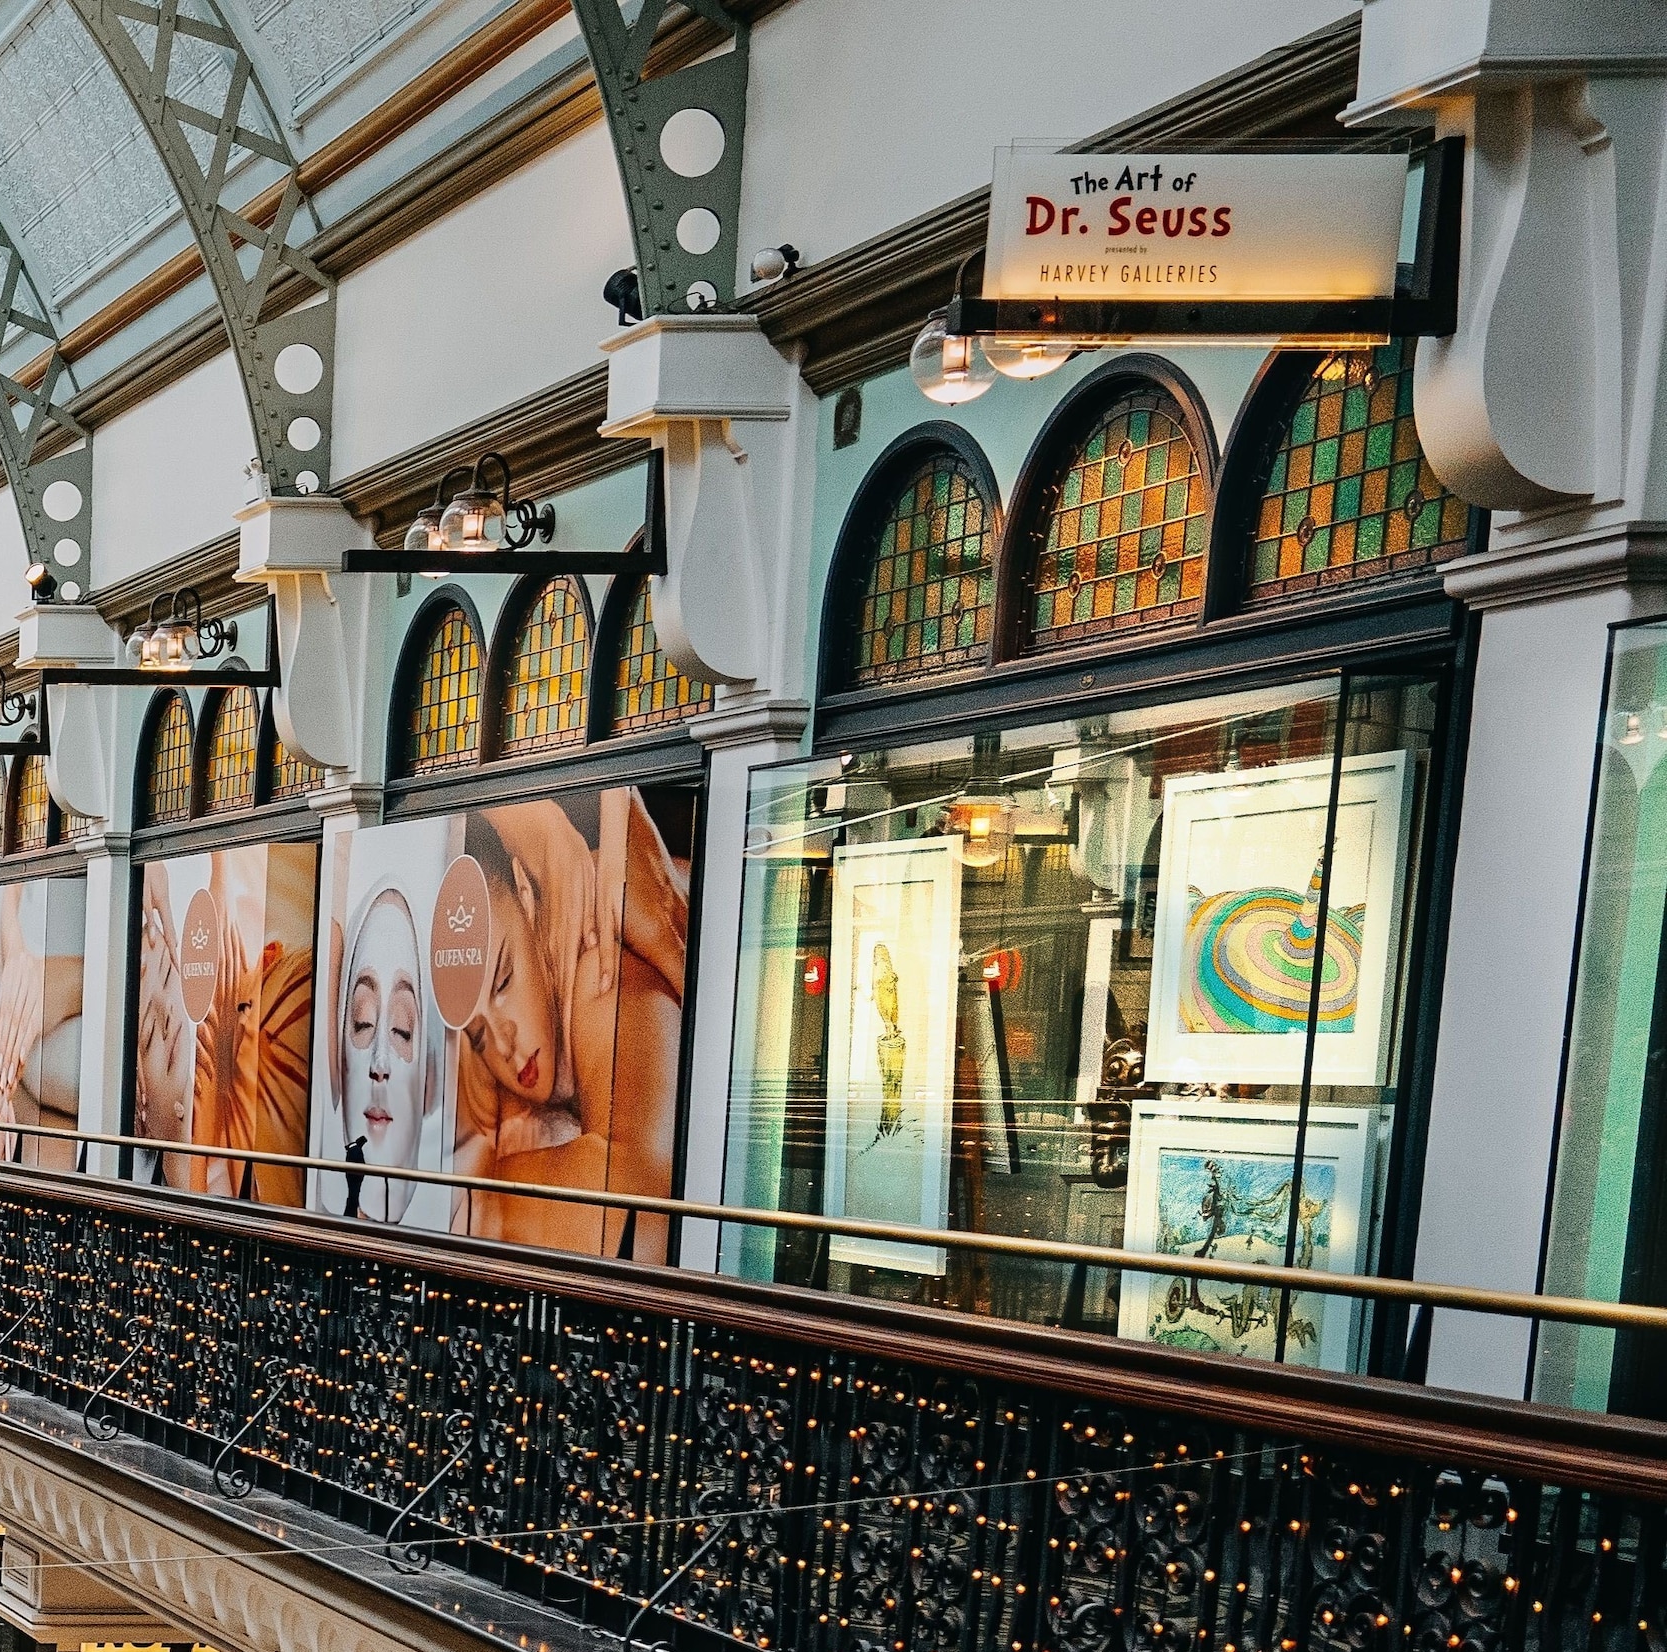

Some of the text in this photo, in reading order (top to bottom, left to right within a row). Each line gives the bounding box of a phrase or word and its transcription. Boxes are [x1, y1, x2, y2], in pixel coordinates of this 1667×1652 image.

[1070, 164, 1197, 195] The Art of
[1026, 196, 1232, 238] Dr. Seuss
[1104, 244, 1147, 254] presented by
[1040, 264, 1217, 283] HARVEY GALLERIES
[434, 947, 482, 968] QUEEN SPA
[184, 962, 214, 980] QUEEN SPA
